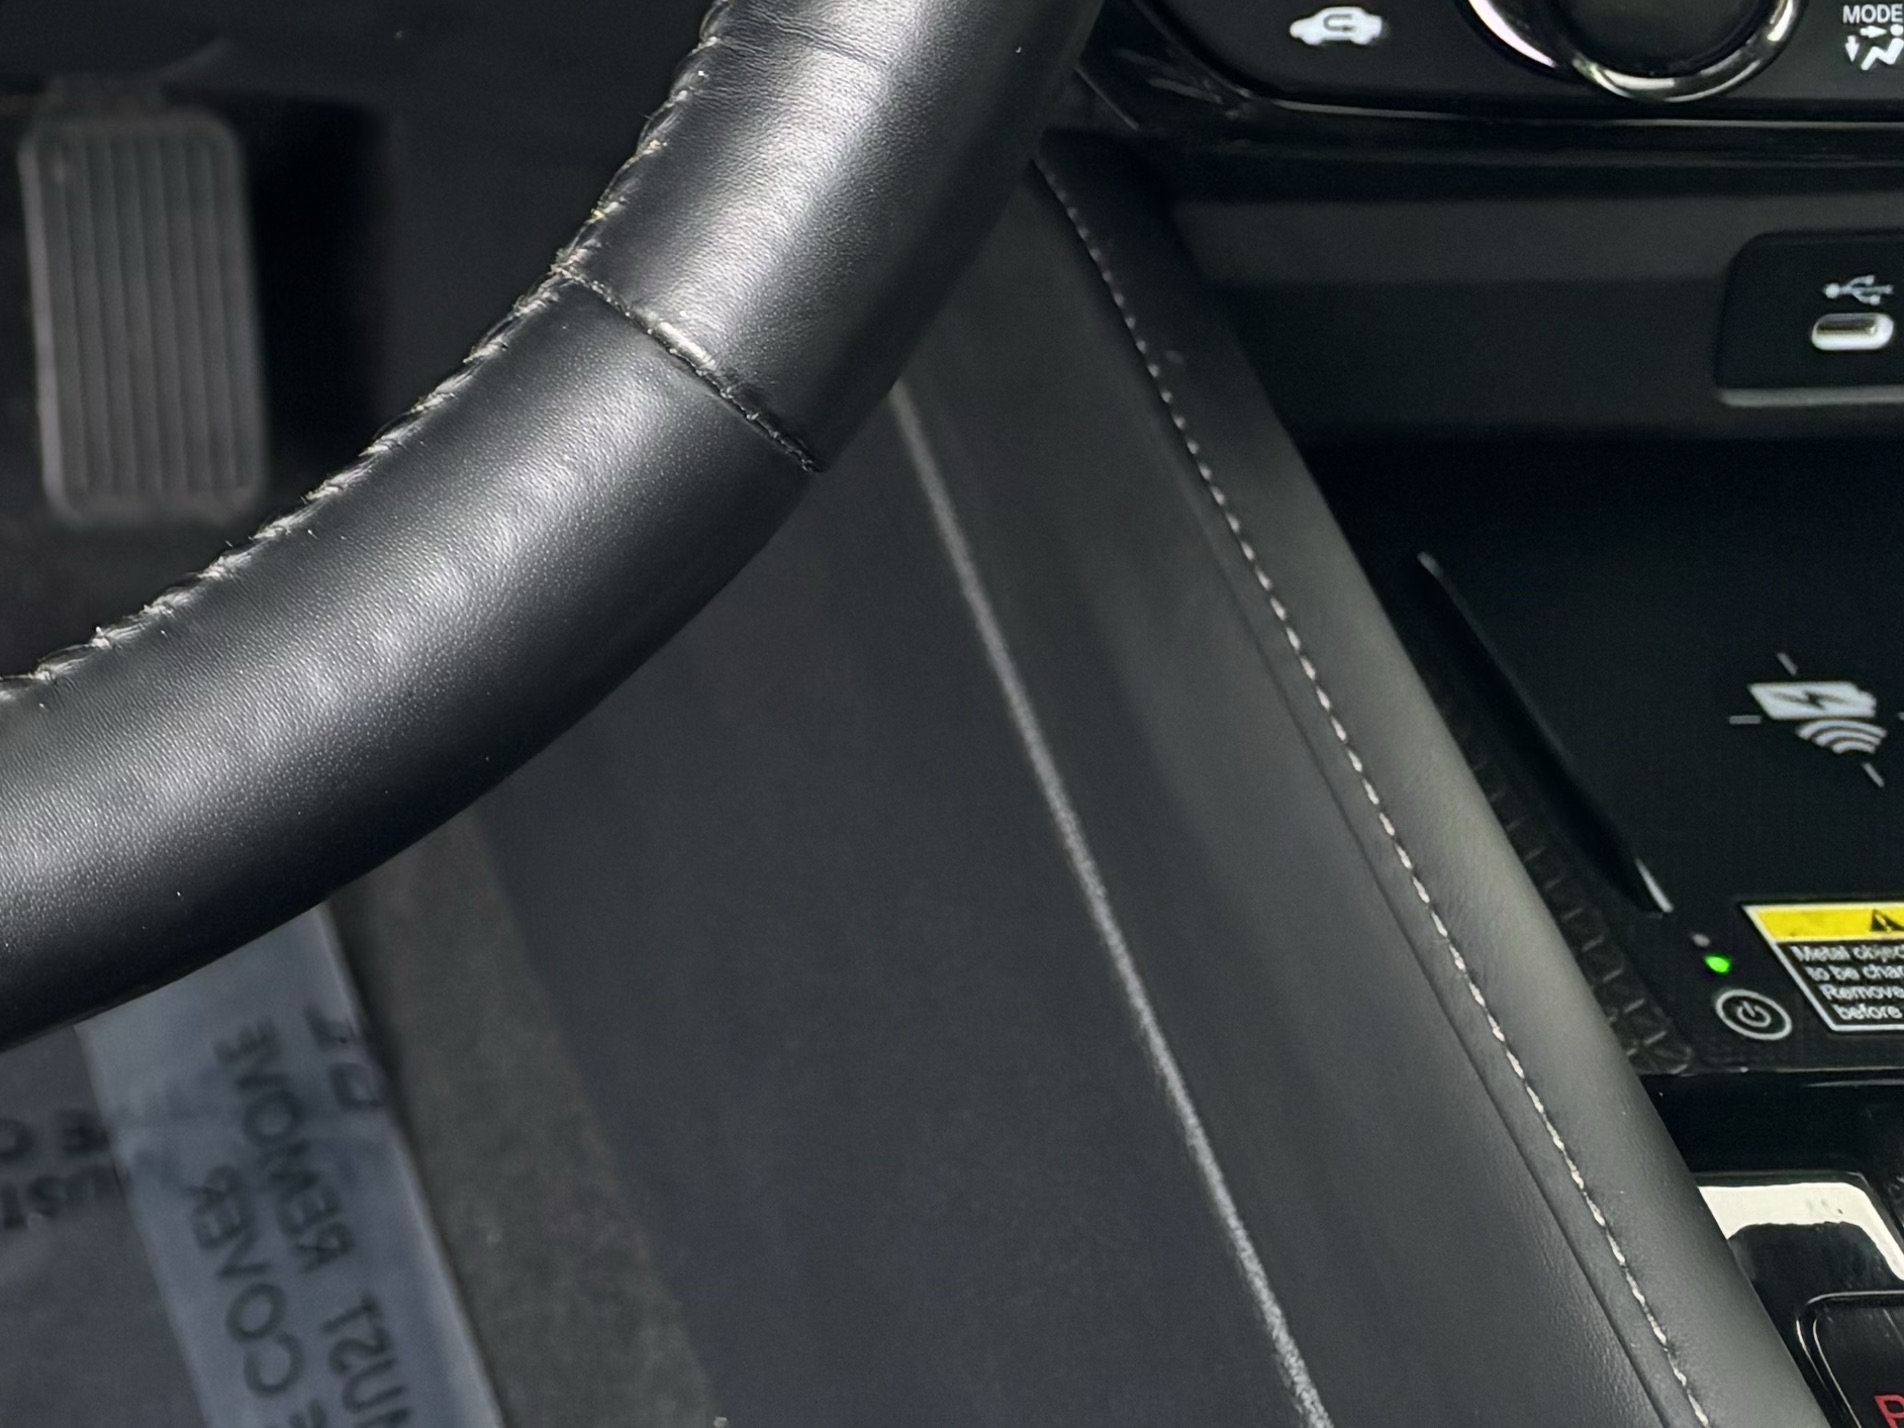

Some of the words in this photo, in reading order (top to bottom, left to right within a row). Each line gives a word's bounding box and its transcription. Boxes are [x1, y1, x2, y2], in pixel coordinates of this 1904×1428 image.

[1789, 945, 1852, 961] Metal
[1804, 965, 1830, 982] to
[1829, 963, 1860, 981] be
[1832, 1002, 1904, 1021] before
